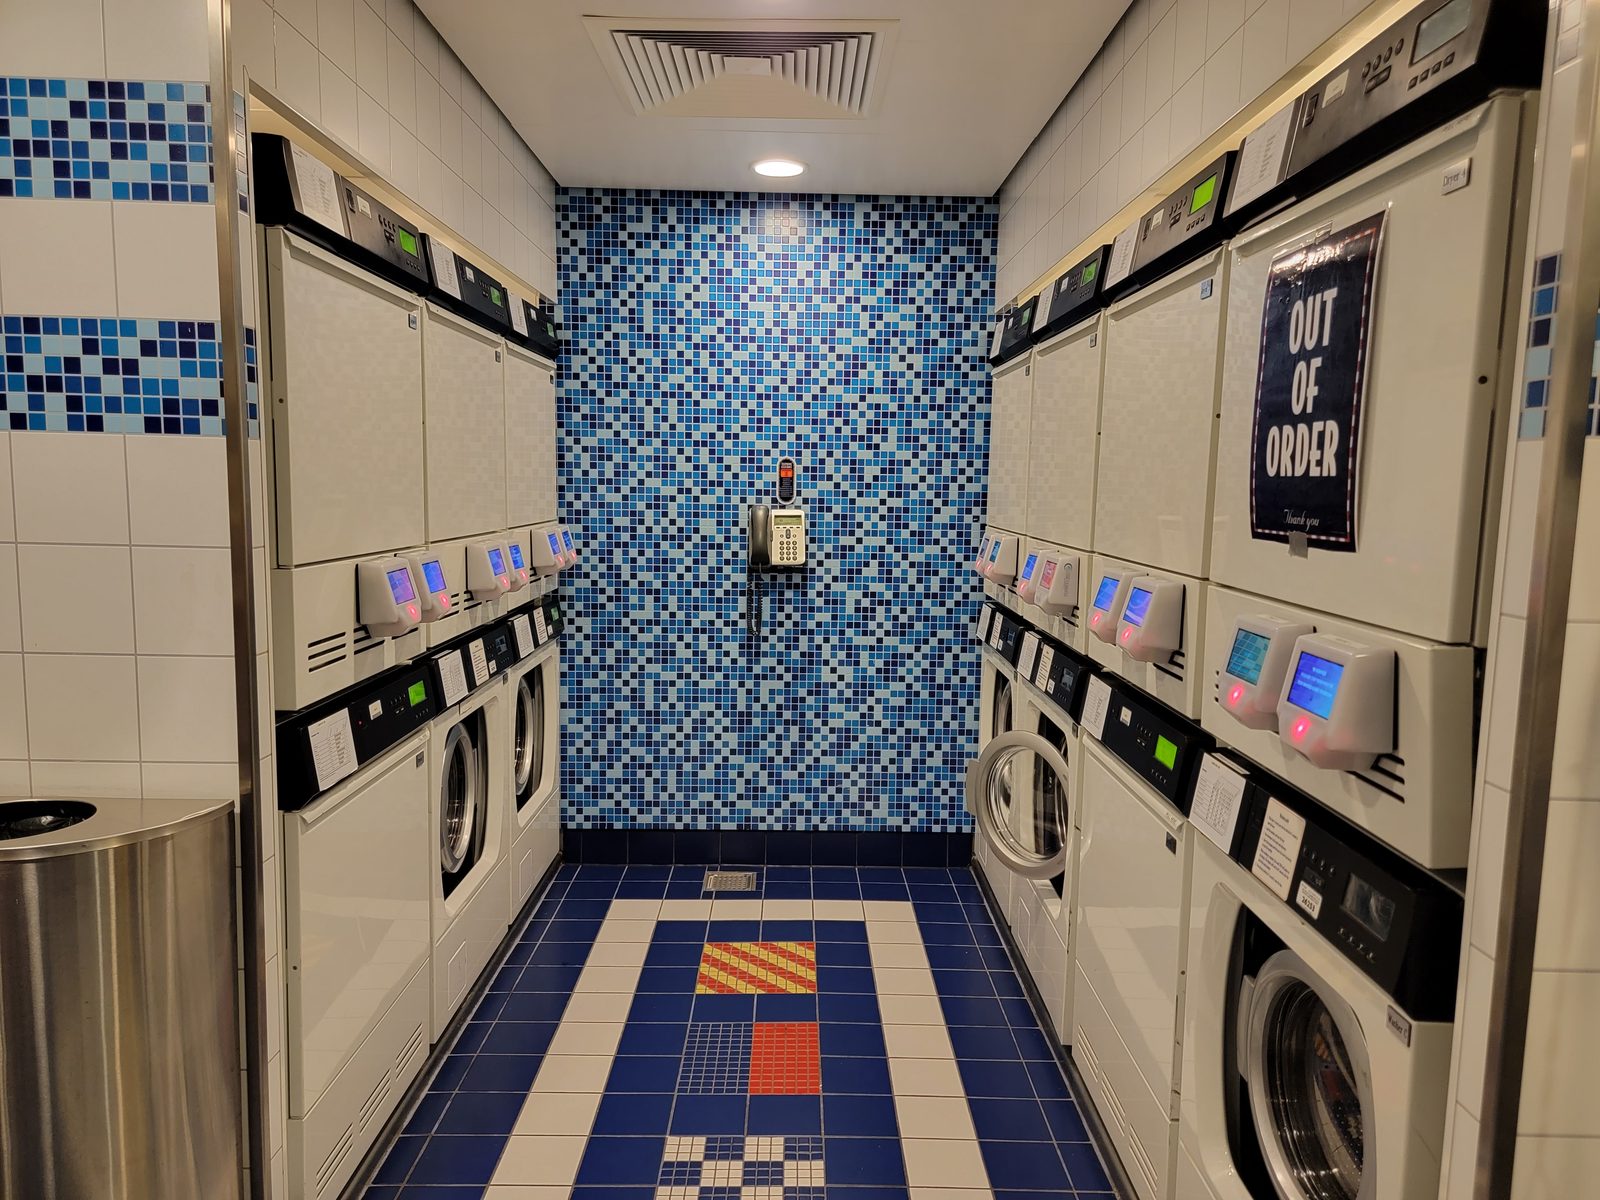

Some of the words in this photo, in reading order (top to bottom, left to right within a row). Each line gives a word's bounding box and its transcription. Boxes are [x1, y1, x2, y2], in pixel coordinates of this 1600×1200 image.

[1289, 288, 1338, 354] OUT
[1291, 357, 1322, 415] OF
[1266, 419, 1339, 477] ORDER
[1283, 509, 1306, 525] Thank
[1305, 518, 1320, 532] you
